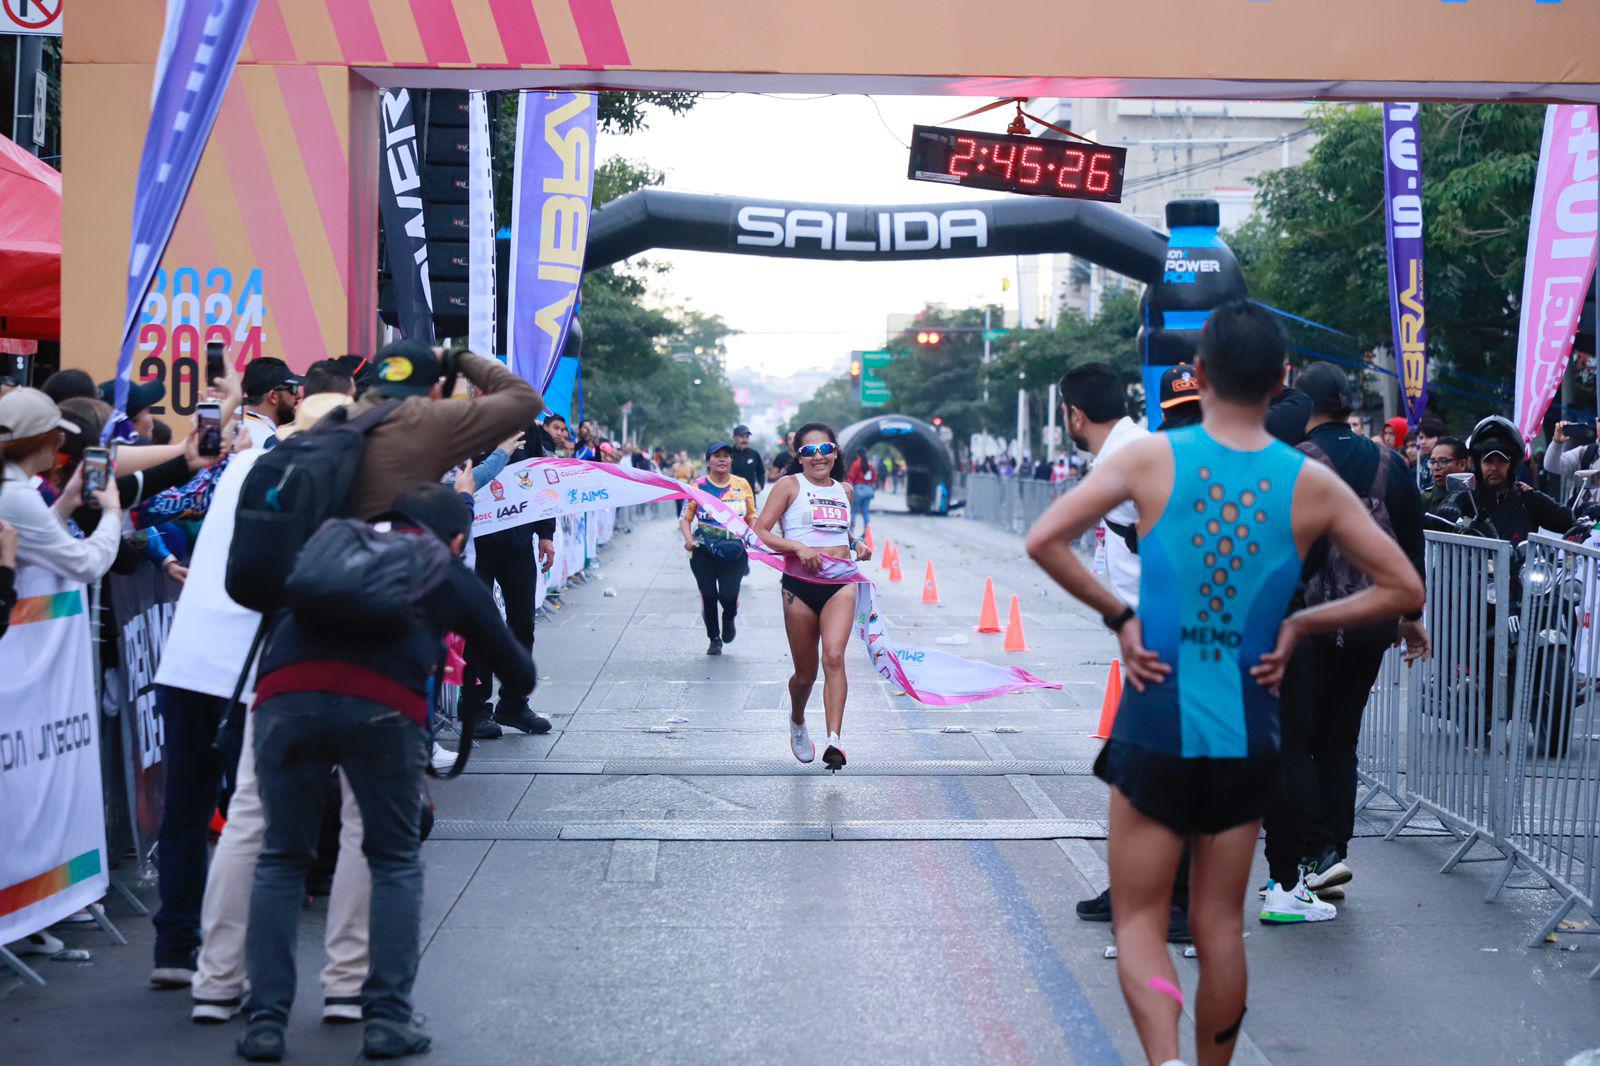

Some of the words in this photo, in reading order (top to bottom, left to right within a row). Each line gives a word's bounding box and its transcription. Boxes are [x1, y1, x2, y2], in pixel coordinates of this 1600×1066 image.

[382, 88, 434, 314] WER
[737, 206, 987, 251] SALIDA
[1163, 271, 1196, 284] ADE
[1165, 260, 1220, 272] POWER
[141, 292, 266, 351] 2024
[1400, 259, 1425, 414] IBRA
[140, 357, 199, 416] 20
[497, 501, 528, 518] IAAF
[582, 489, 609, 503] AIMS
[822, 507, 842, 519] 159
[1181, 628, 1243, 648] MEMO
[38, 713, 91, 761] JAECOO
